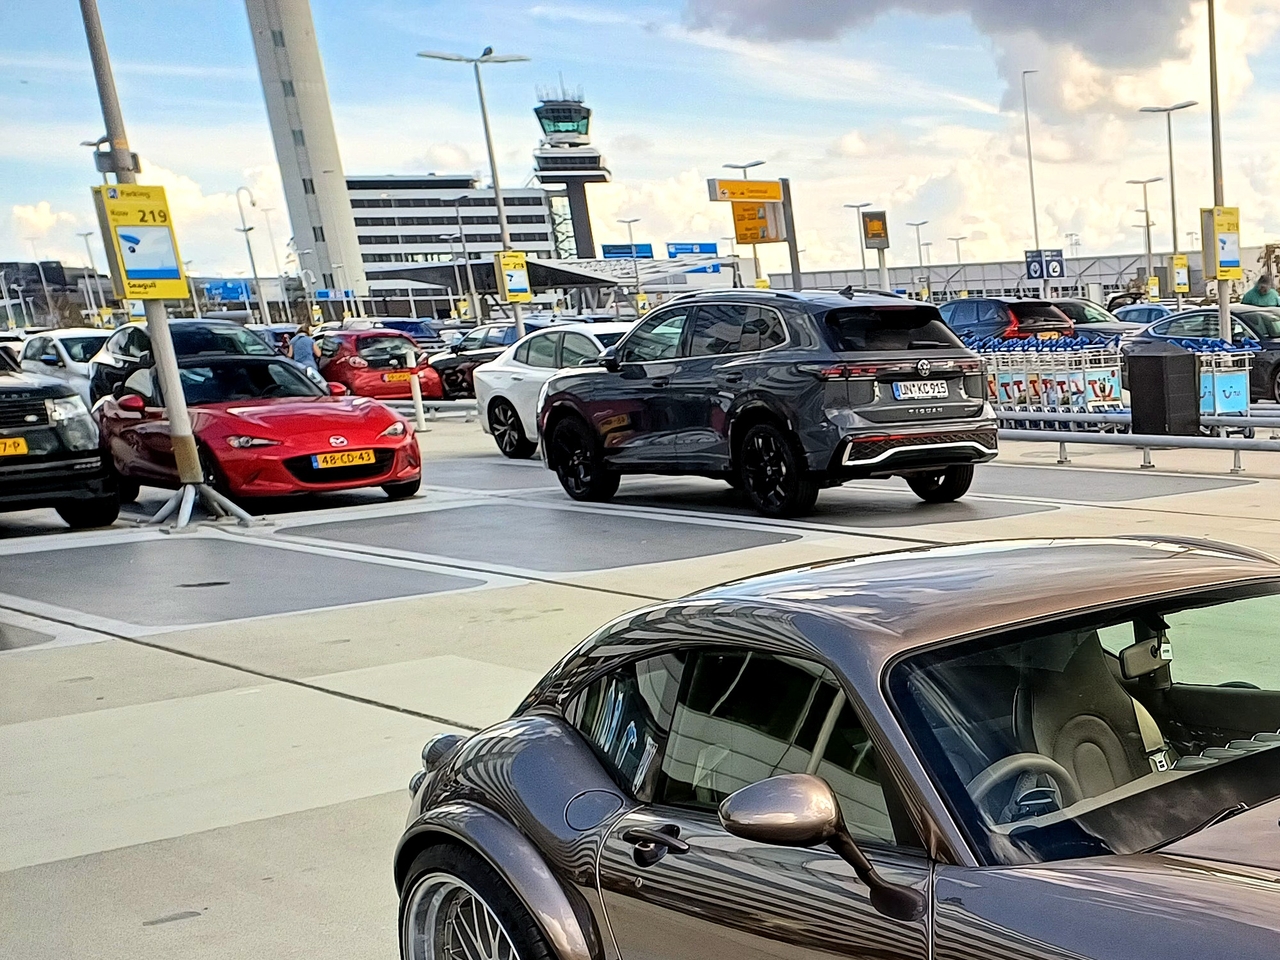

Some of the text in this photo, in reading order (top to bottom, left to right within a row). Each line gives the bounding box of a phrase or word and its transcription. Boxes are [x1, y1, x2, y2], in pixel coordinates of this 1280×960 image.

[138, 209, 168, 223] 219
[917, 384, 930, 394] KC
[930, 382, 947, 394] 915
[322, 451, 371, 466] 48-CD-43
